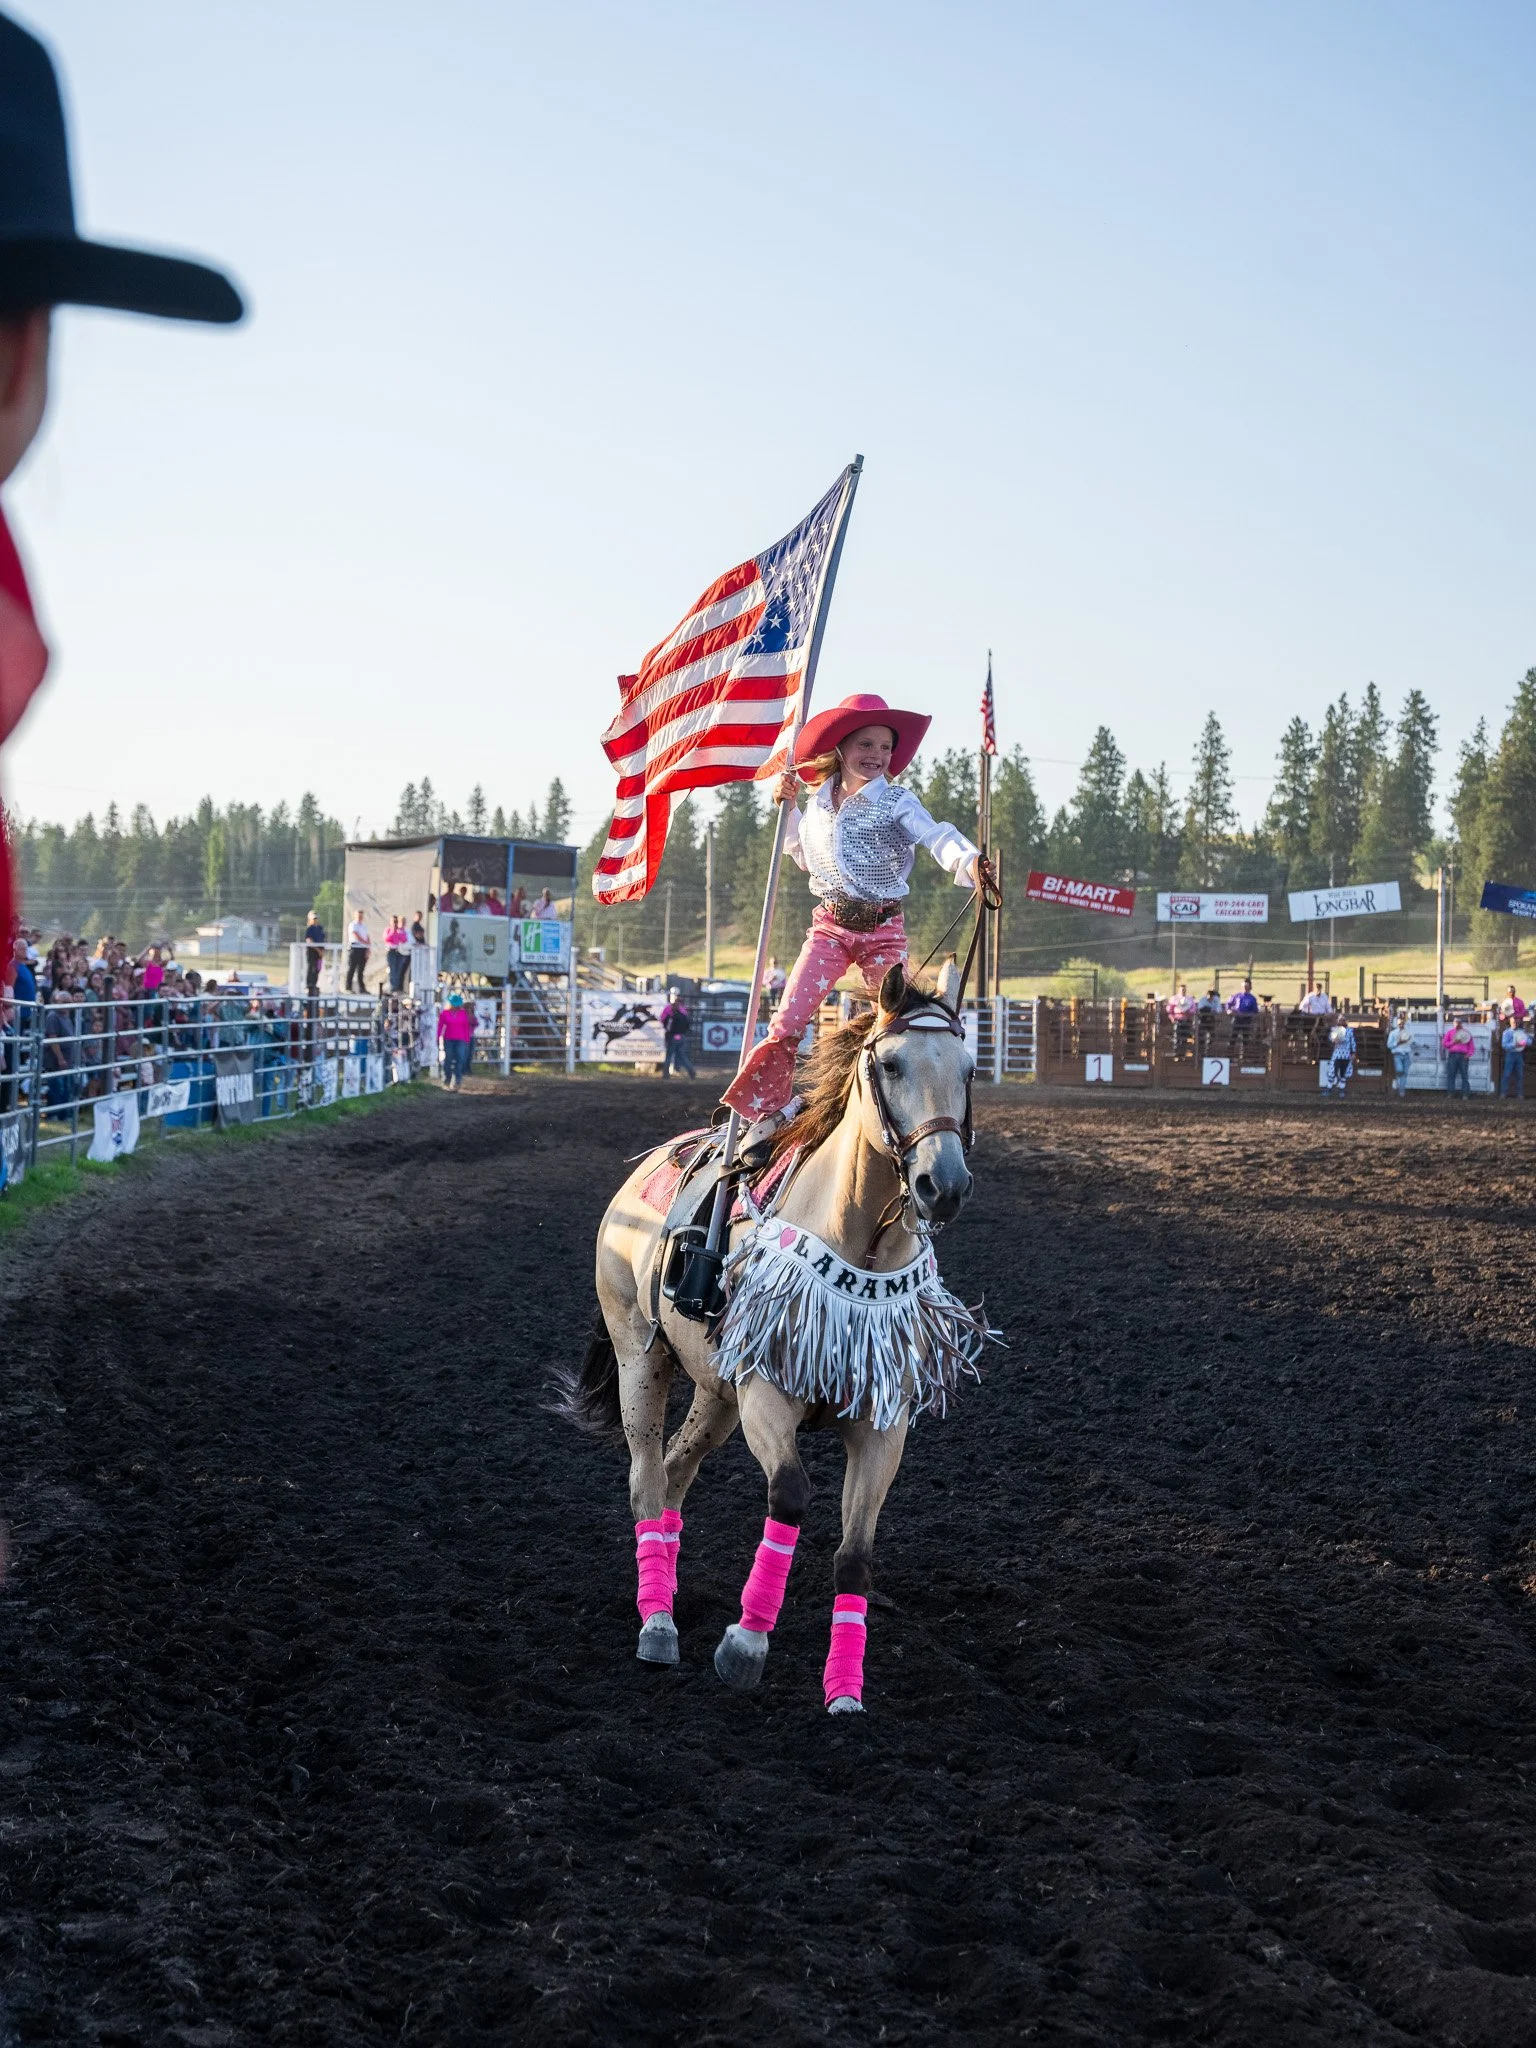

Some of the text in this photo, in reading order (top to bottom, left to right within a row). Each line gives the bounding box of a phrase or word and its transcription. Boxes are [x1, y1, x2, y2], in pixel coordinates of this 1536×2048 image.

[1058, 894, 1069, 903] FOR
[1090, 901, 1101, 909] AND
[1116, 907, 1130, 915] PARK
[1174, 903, 1193, 912] CAL
[1093, 1056, 1104, 1081] 1
[1209, 1059, 1224, 1085] 2
[793, 1233, 931, 1300] LARAMIE
